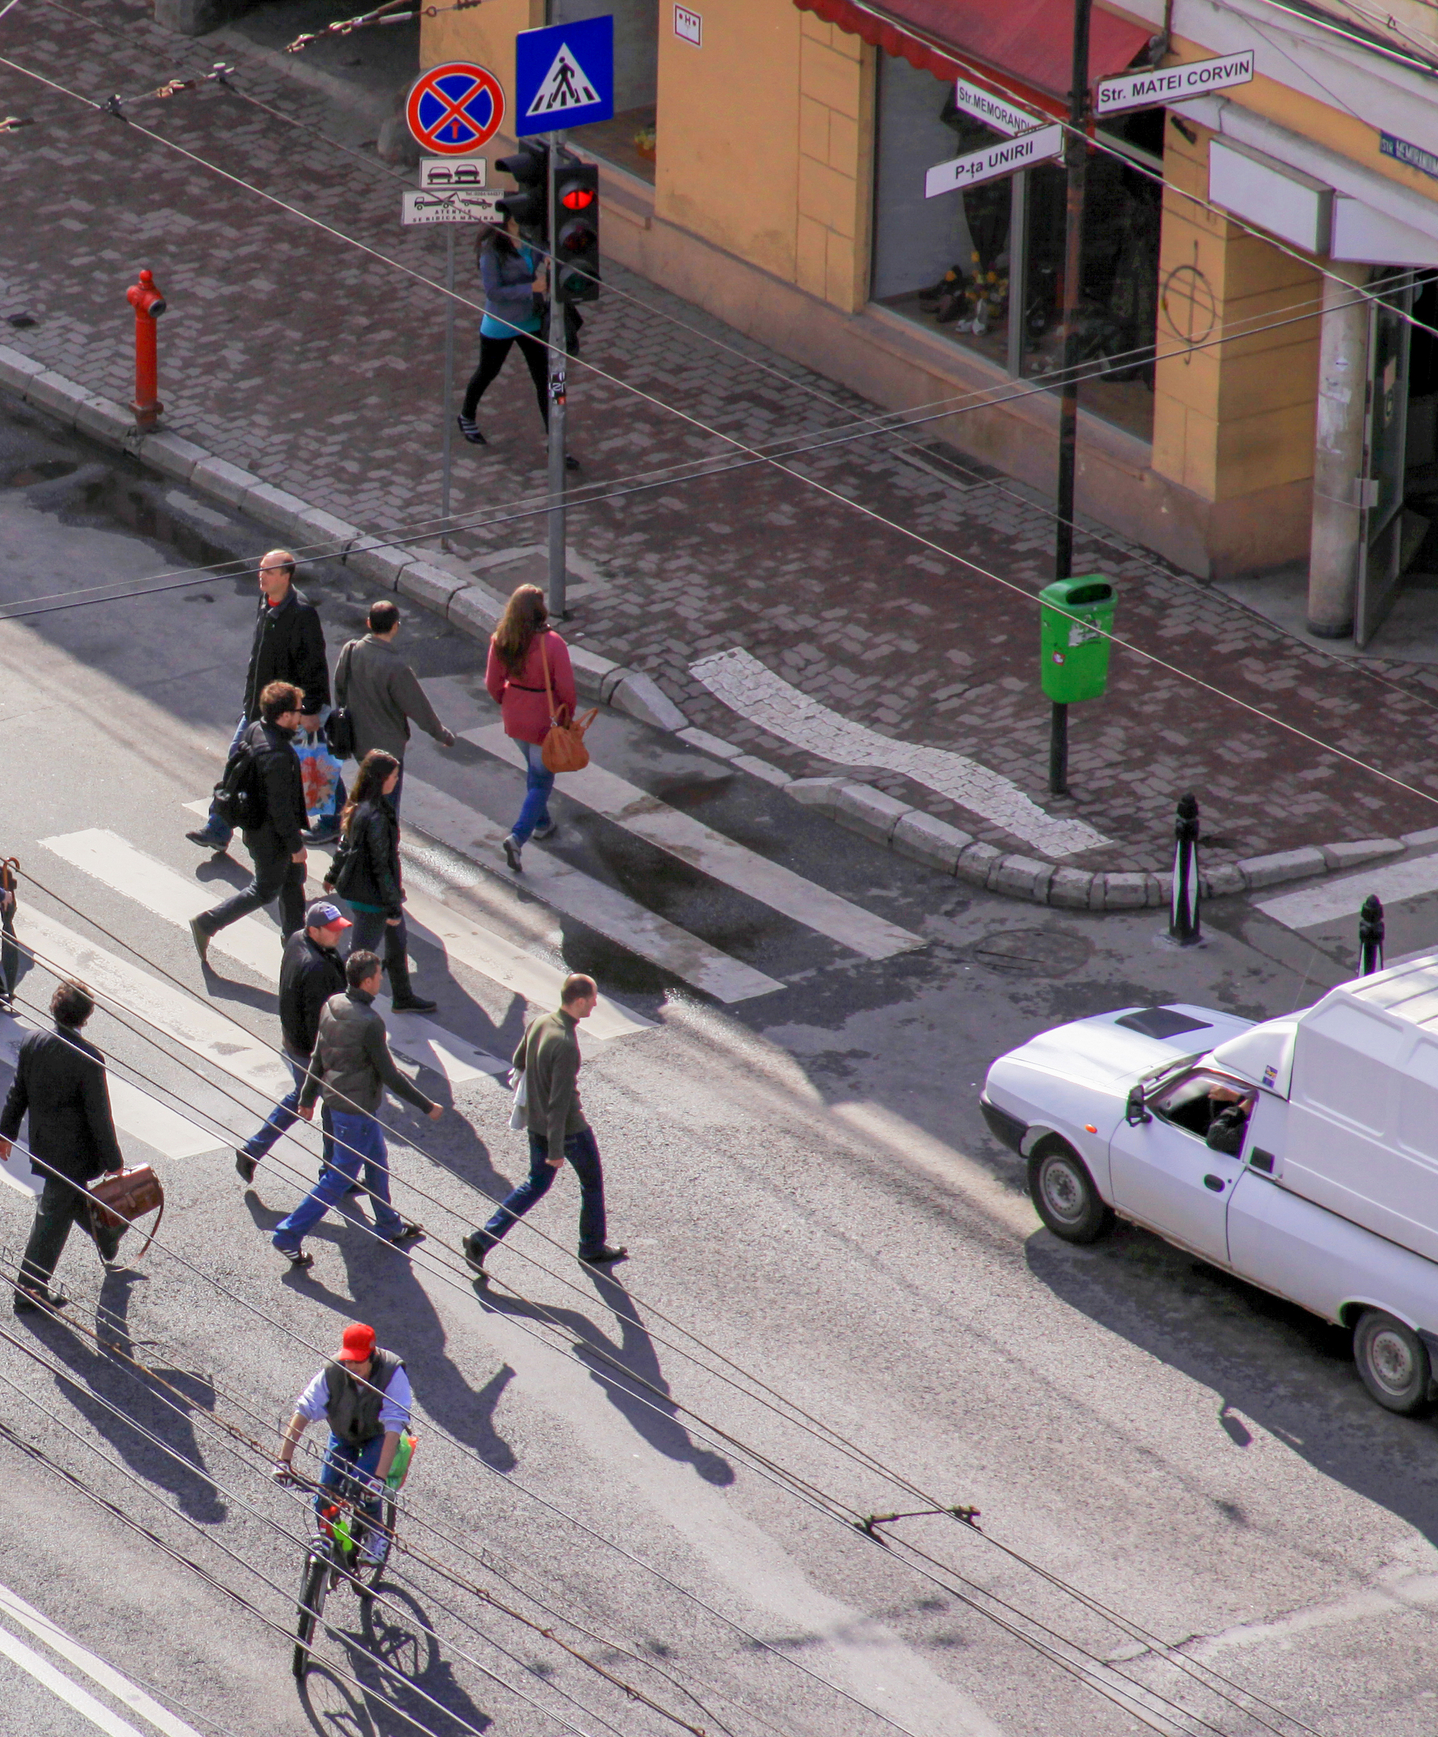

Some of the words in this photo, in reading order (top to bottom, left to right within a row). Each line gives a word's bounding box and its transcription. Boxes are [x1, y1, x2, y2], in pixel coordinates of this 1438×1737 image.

[1100, 88, 1127, 103] Str.
[1132, 74, 1182, 97] MATEI
[1187, 60, 1250, 86] CORVIN
[988, 140, 1034, 168] UNIRII
